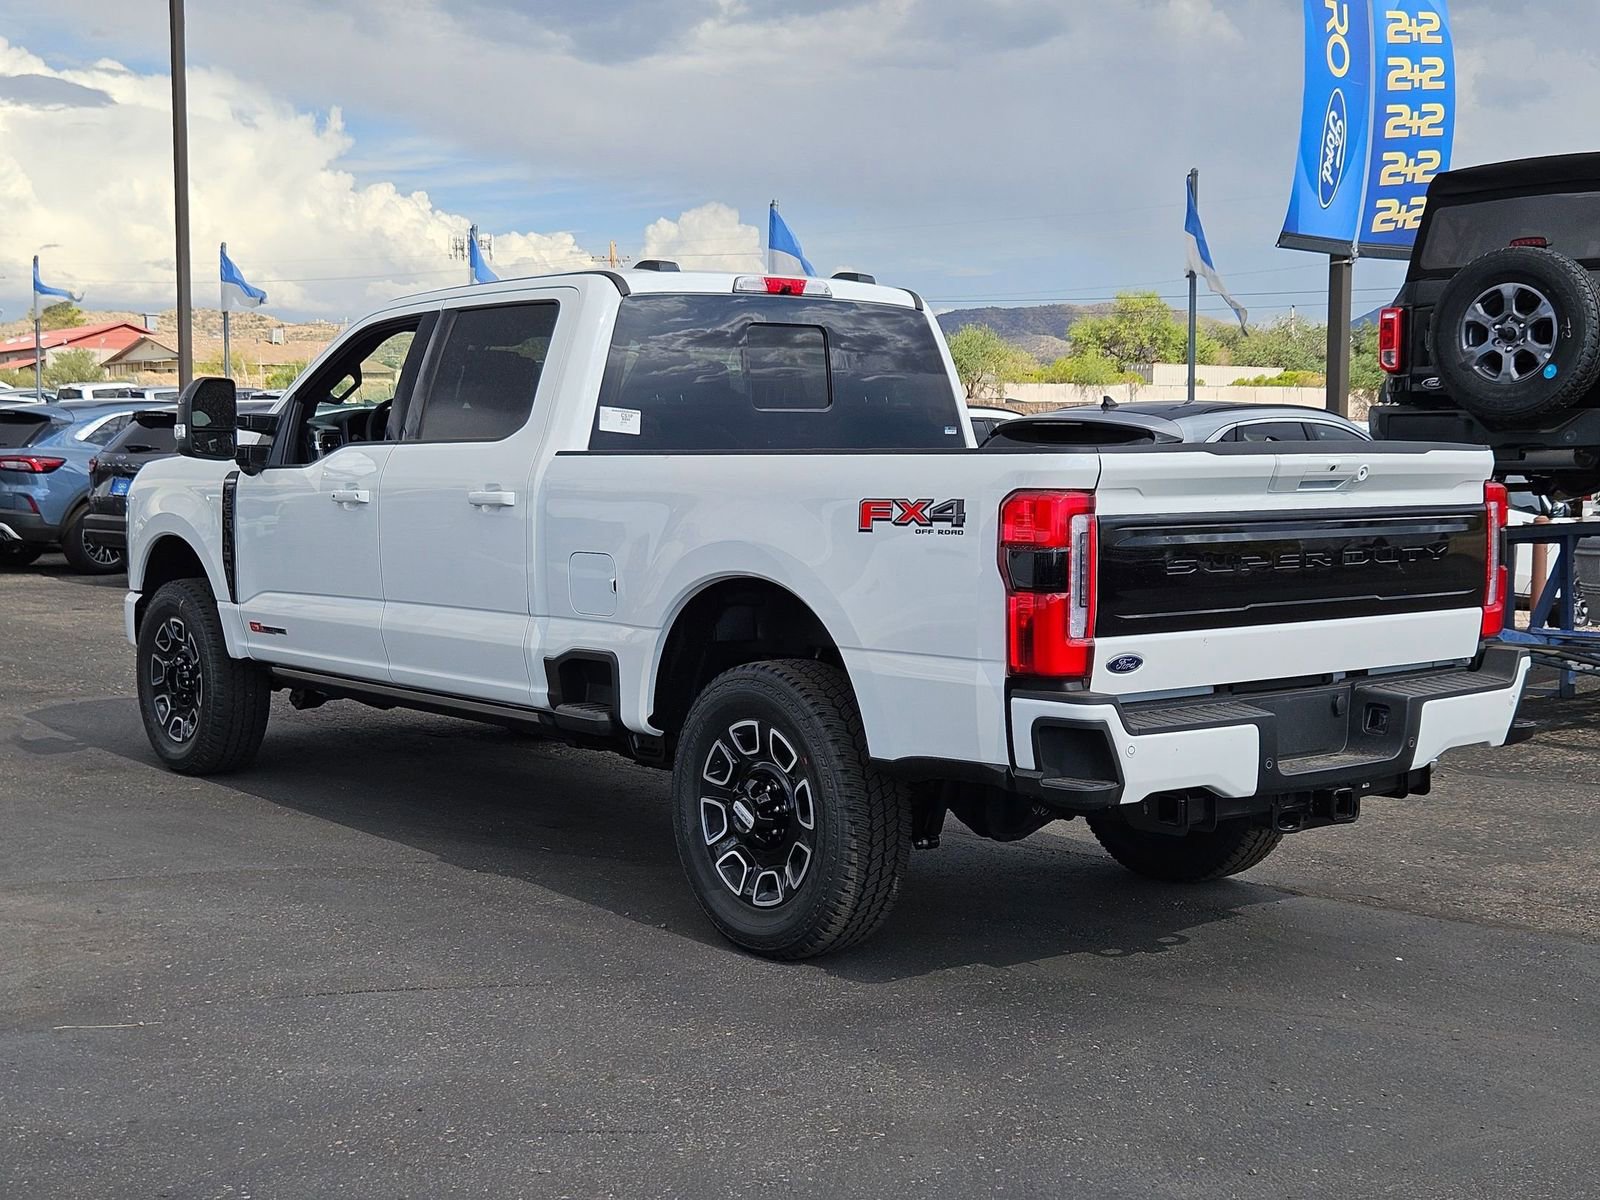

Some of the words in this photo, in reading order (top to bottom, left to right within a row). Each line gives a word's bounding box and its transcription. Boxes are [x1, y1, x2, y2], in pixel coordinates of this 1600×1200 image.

[1322, 110, 1343, 186] Ford
[858, 498, 966, 533] FX4
[937, 528, 964, 536] ROAD
[1166, 551, 1332, 576] SUPER
[1342, 545, 1448, 567] DUTY
[1115, 657, 1137, 670] Ford
